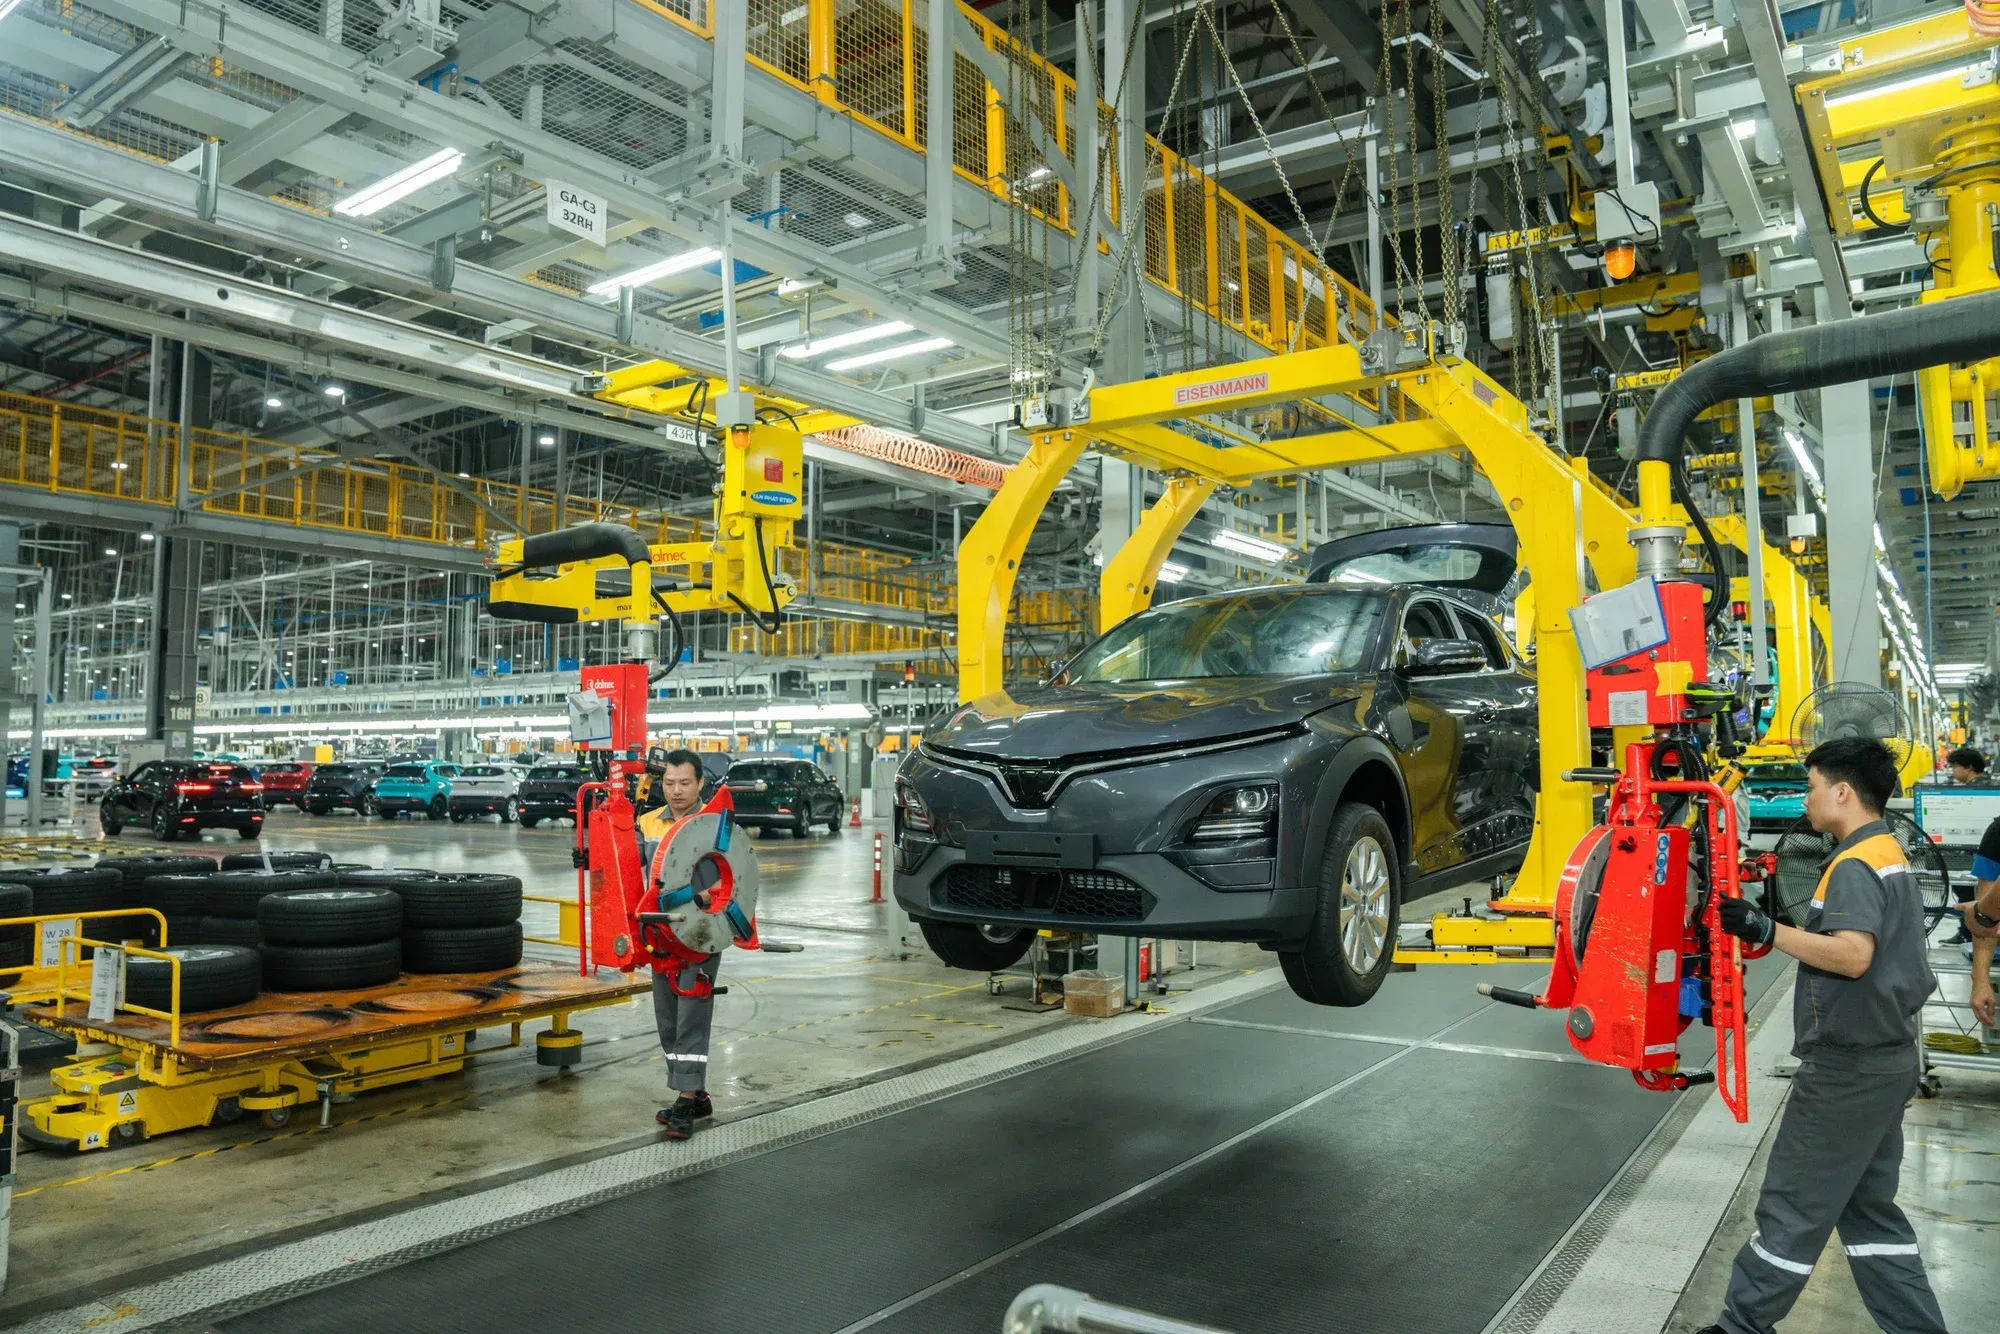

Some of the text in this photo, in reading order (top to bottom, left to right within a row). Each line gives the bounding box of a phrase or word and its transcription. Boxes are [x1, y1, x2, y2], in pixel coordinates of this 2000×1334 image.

[560, 190, 596, 214] GA-C3
[562, 208, 593, 231] 32RH
[1177, 376, 1266, 403] EISENMANN
[169, 707, 193, 720] 16H
[45, 929, 71, 939] W 28
[86, 1135, 99, 1145] 64
